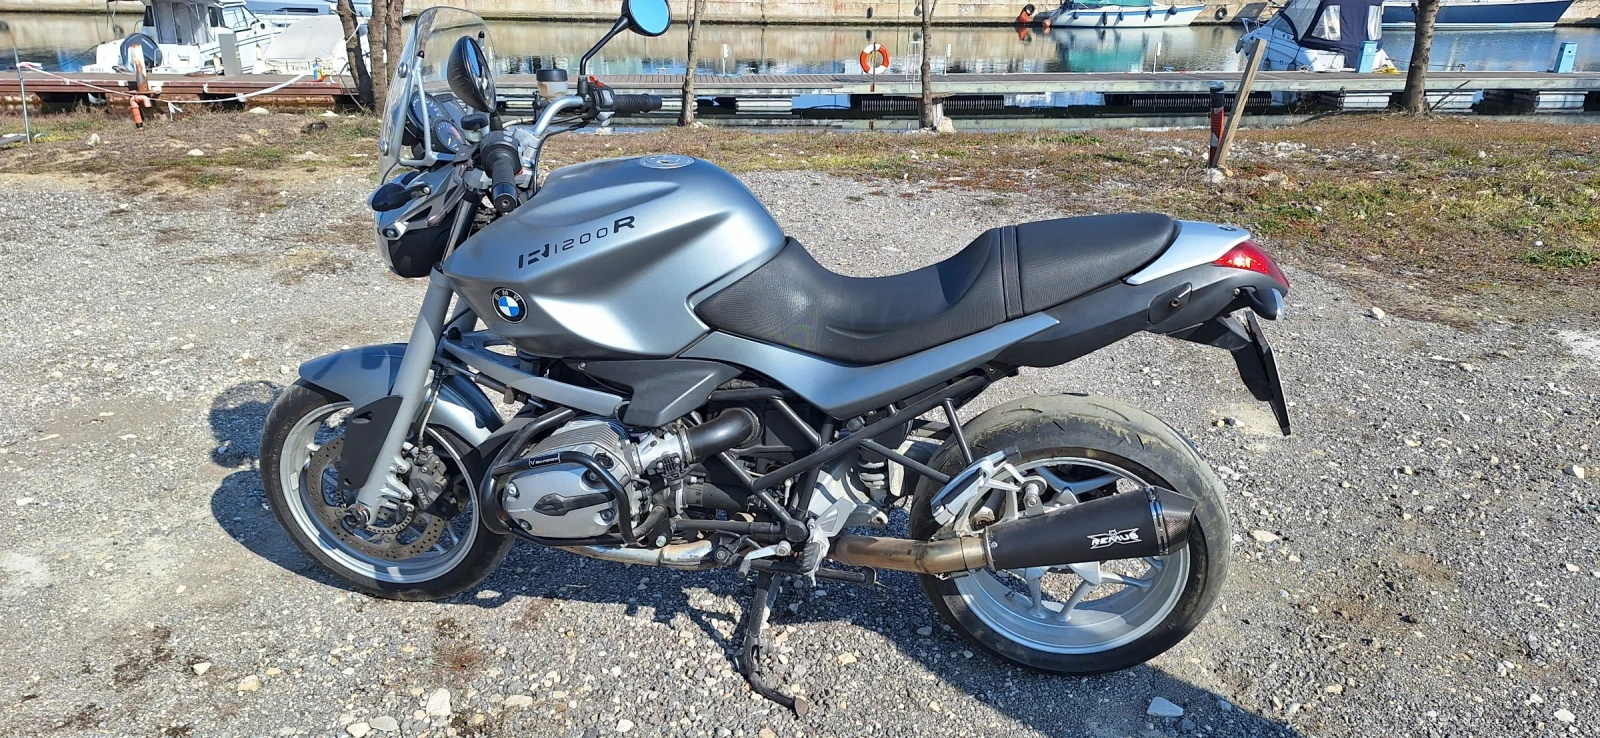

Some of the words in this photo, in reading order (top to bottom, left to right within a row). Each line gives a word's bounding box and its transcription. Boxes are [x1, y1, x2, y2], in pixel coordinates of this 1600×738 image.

[494, 289, 521, 302] BMW
[415, 487, 430, 505] BMW
[1091, 532, 1139, 546] REMUS
